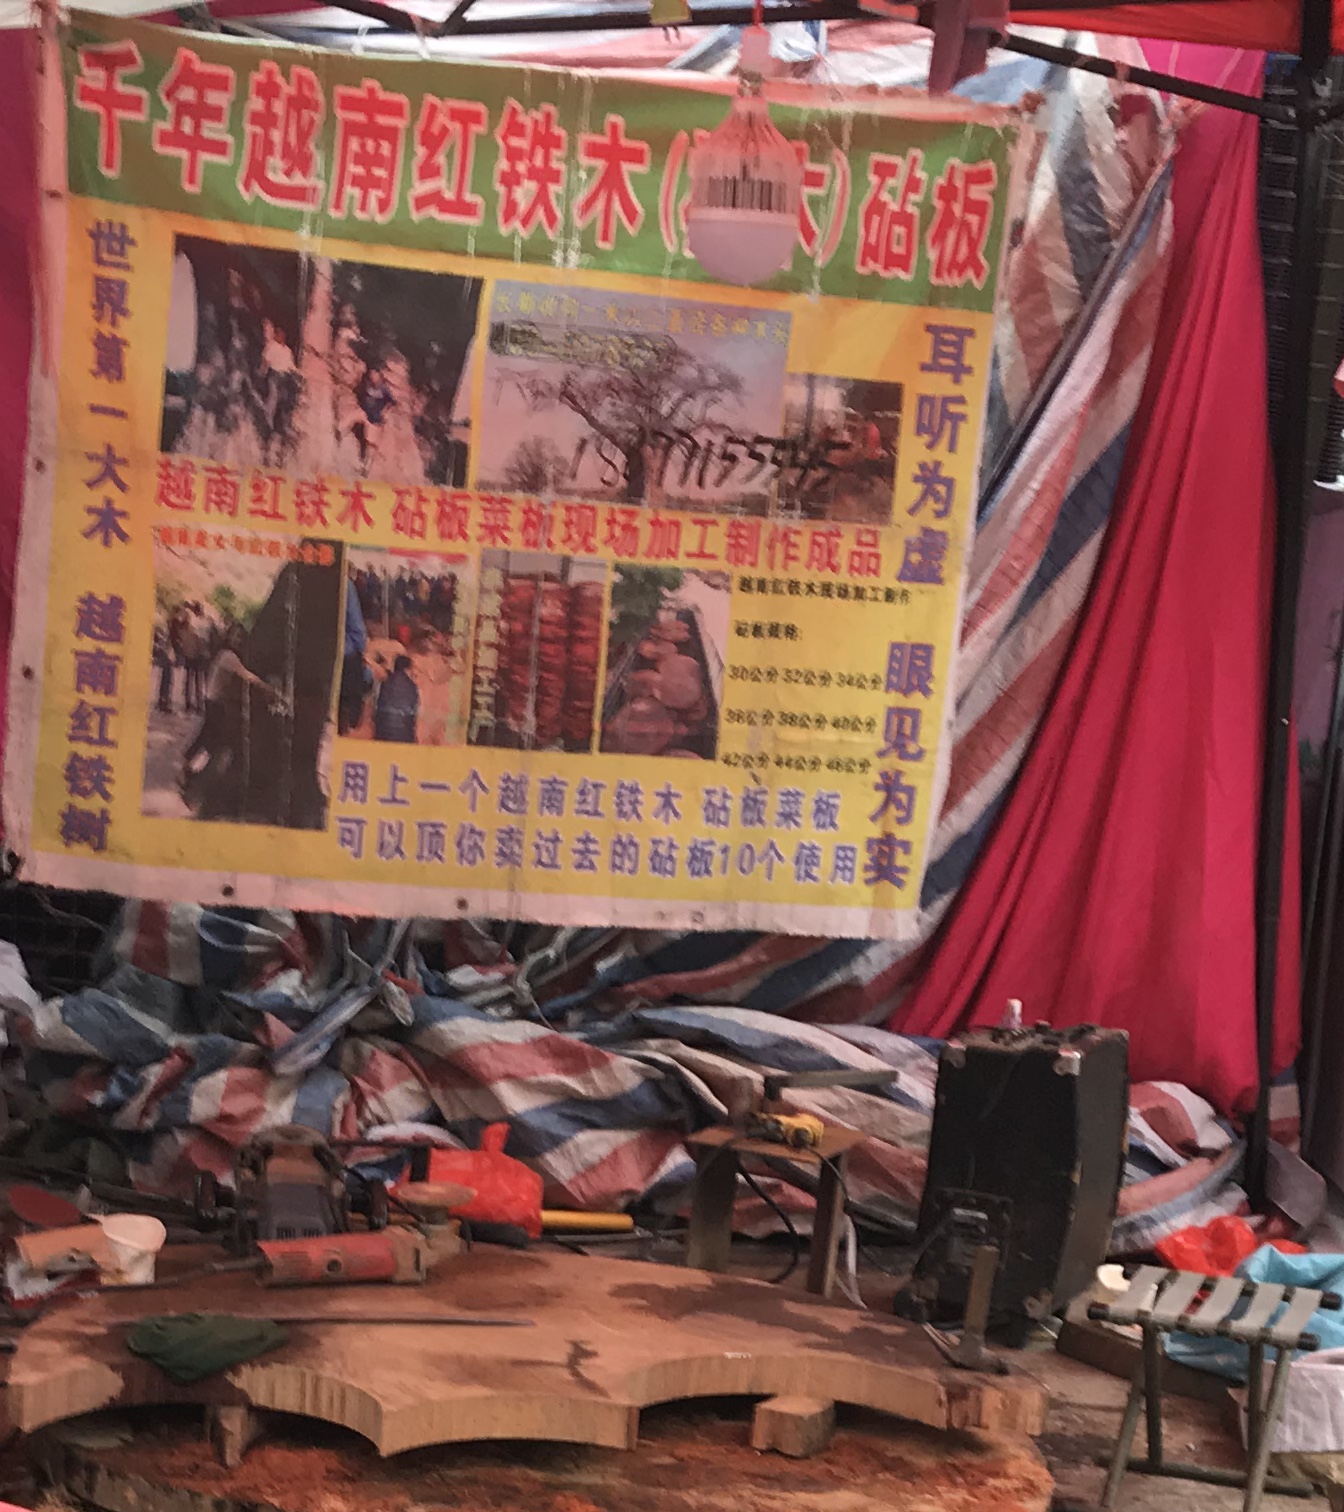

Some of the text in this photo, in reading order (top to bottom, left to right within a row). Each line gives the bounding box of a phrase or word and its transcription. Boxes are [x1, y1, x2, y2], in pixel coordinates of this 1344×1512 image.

[75, 39, 998, 290] 千年越南红铁木()砧板
[59, 218, 138, 852] 世界第一大木 越南红铁树
[155, 452, 377, 532] 越南红铁木
[390, 484, 883, 578] 砧板菜板现场加工制作成品
[863, 323, 976, 890] 耳听为虚 眼见为实
[337, 759, 843, 833] 用上一个越南红铁木 砧板菜板
[337, 815, 859, 887] 可以顶你卖过去的砧板10个使用
